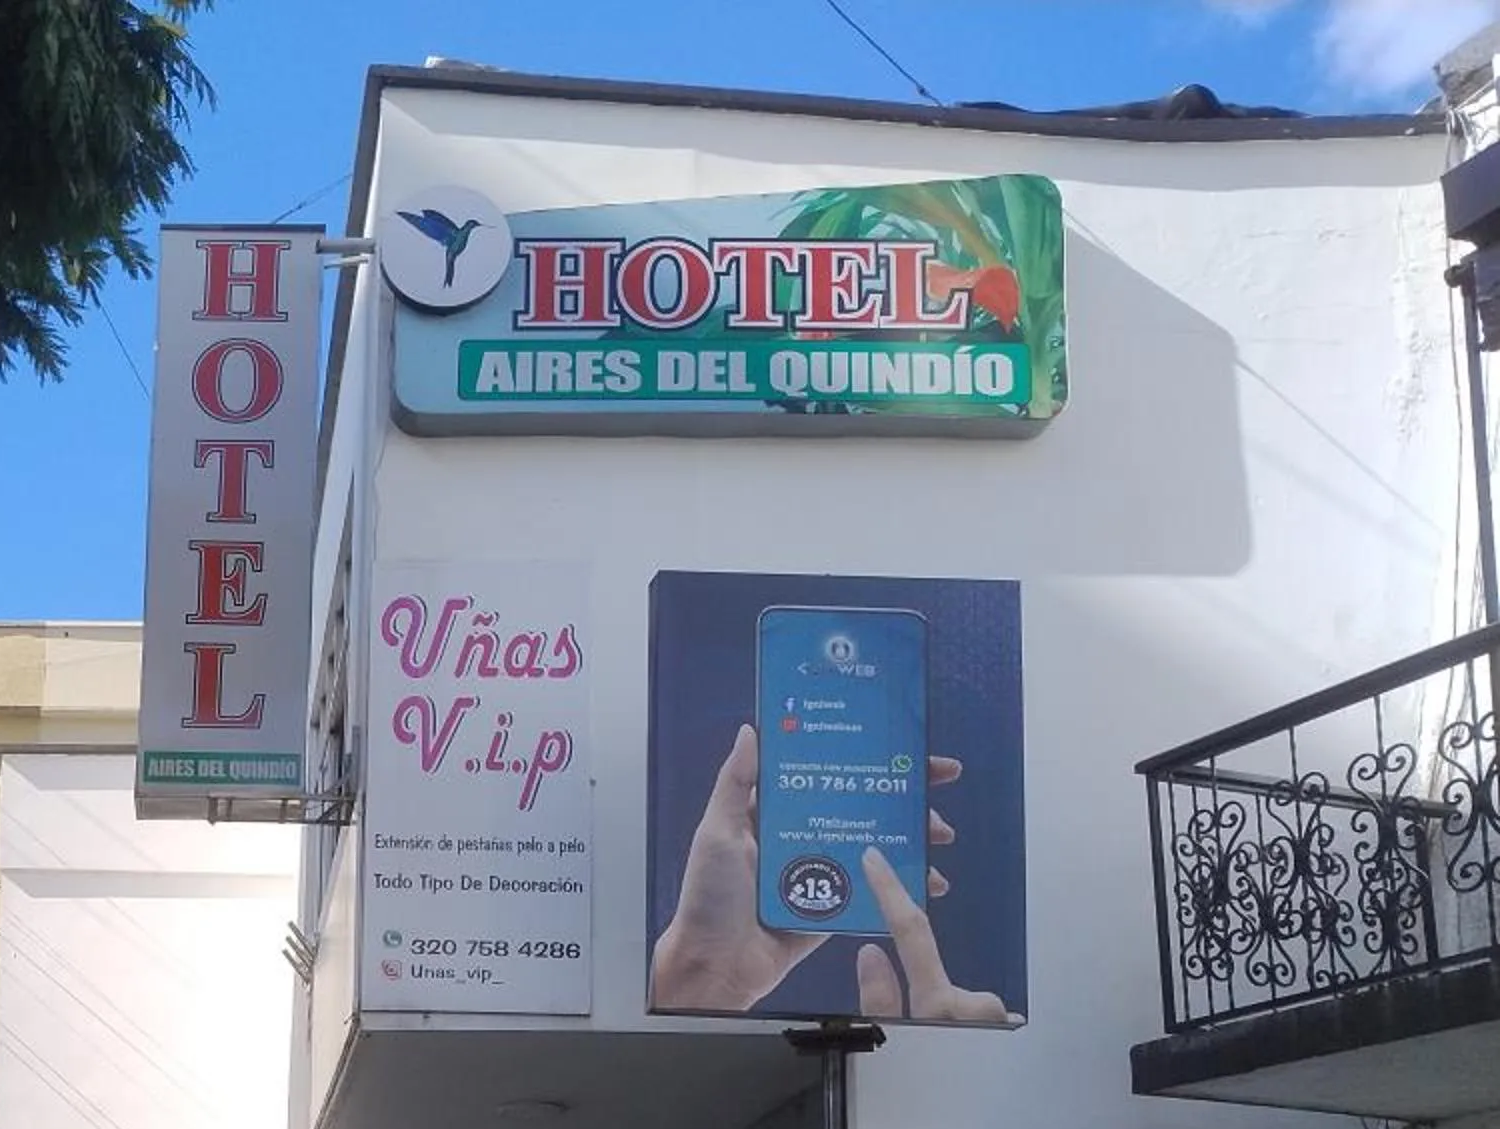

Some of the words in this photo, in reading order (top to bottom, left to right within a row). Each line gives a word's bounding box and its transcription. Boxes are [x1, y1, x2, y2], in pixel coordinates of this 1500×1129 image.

[514, 236, 973, 332] HOTEL
[475, 350, 642, 394] AIRES
[658, 351, 756, 394] DEL
[770, 345, 1014, 399] QUINDÍO
[182, 240, 291, 729] HOTEL
[381, 594, 583, 678] Uñas
[148, 758, 194, 778] AIRES
[198, 759, 226, 778] DEL
[230, 758, 297, 780] QUINDÍO
[392, 695, 573, 811] V.i.p
[778, 775, 814, 789] 301
[820, 775, 857, 791] 786
[864, 778, 908, 794] 2011
[438, 834, 453, 850] de
[457, 836, 513, 854] pestañas
[517, 836, 543, 856] pelo
[547, 840, 555, 853] a
[559, 838, 586, 857] pelo
[374, 873, 413, 889] Todo
[419, 874, 454, 894] Tipo
[461, 875, 483, 891] De
[489, 876, 584, 894] Decoración
[411, 939, 457, 956] 320
[466, 941, 509, 958] 758
[517, 942, 582, 960] 4286
